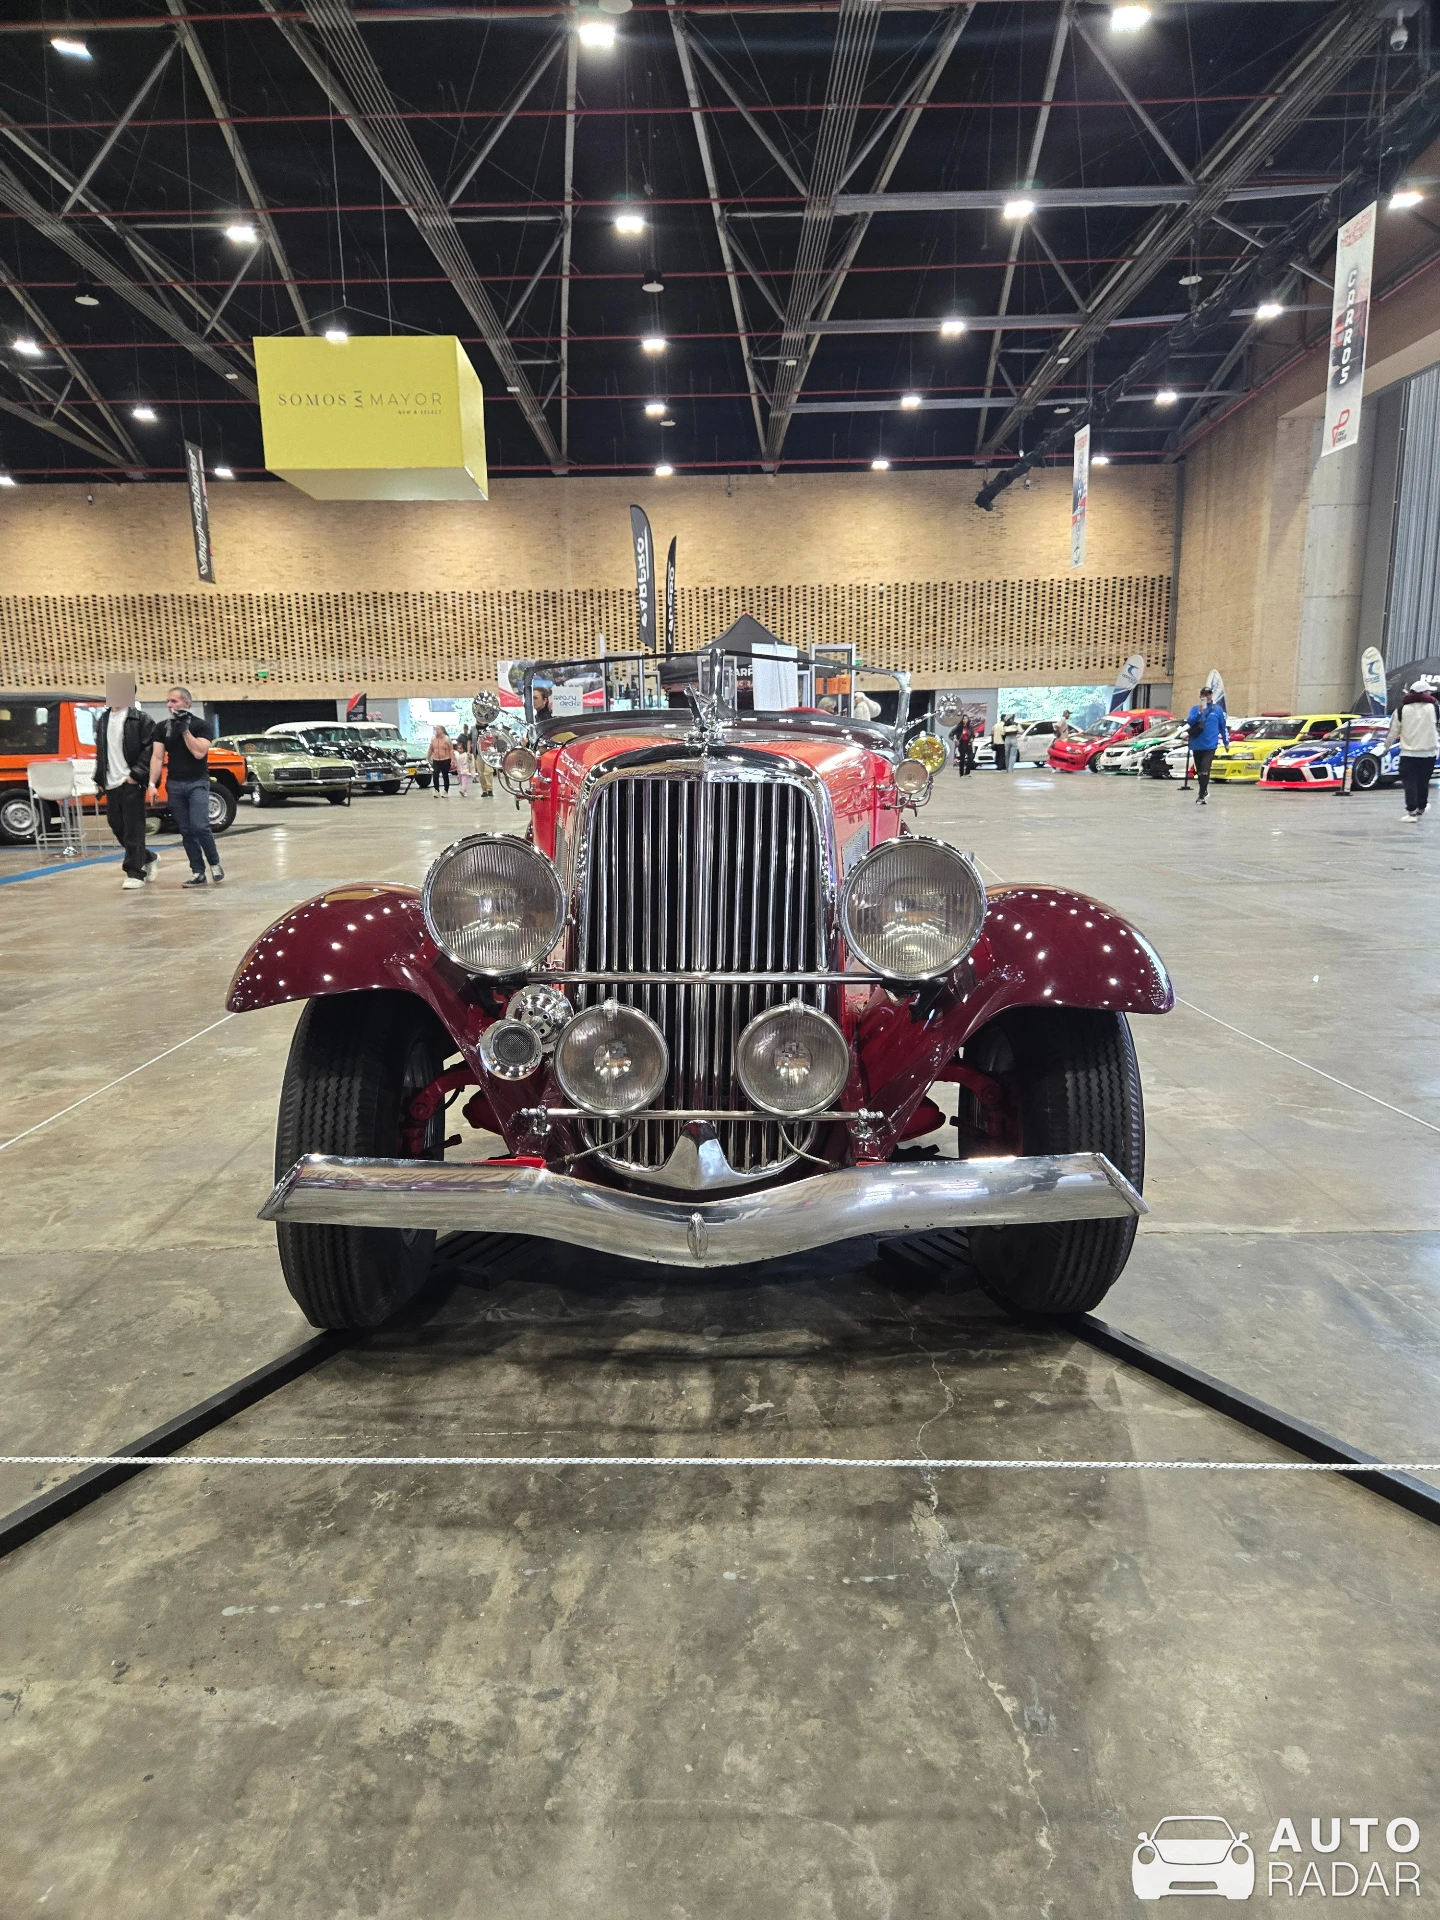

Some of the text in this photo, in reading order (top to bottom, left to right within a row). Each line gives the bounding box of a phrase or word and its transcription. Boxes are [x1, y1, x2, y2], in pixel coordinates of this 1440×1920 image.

[1339, 268, 1358, 385] CARROS
[278, 391, 443, 408] SOMOS MAYOR
